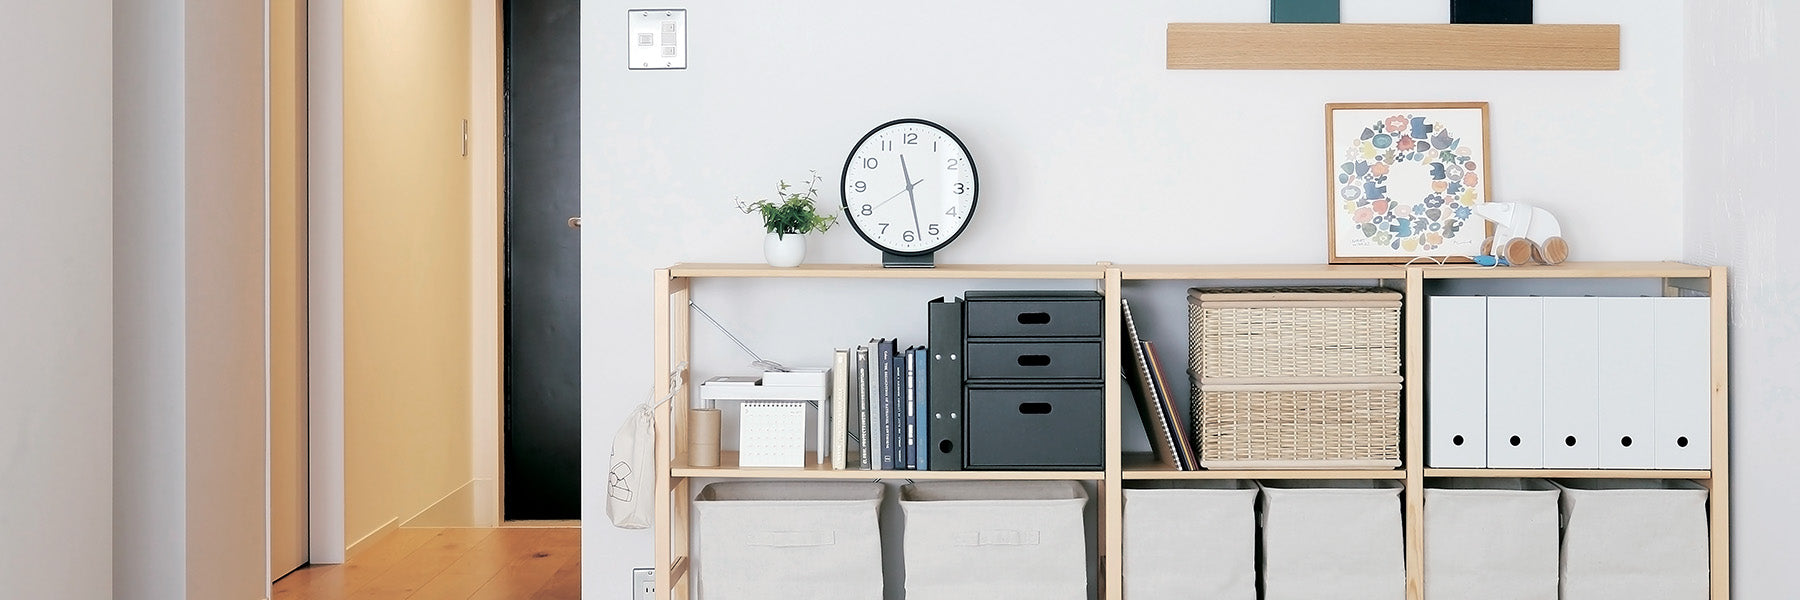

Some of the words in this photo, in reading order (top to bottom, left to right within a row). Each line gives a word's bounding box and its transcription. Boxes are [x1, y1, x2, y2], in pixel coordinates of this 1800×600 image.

[903, 133, 918, 145] 12
[882, 140, 892, 151] 11
[933, 141, 937, 152] 1
[863, 157, 878, 169] 10
[947, 158, 958, 170] 2
[855, 181, 866, 192] 9
[953, 183, 964, 194] 3
[861, 204, 873, 216] 8
[945, 206, 957, 217] 4
[878, 223, 889, 234] 7
[928, 224, 939, 236] 5
[903, 231, 914, 242] 6
